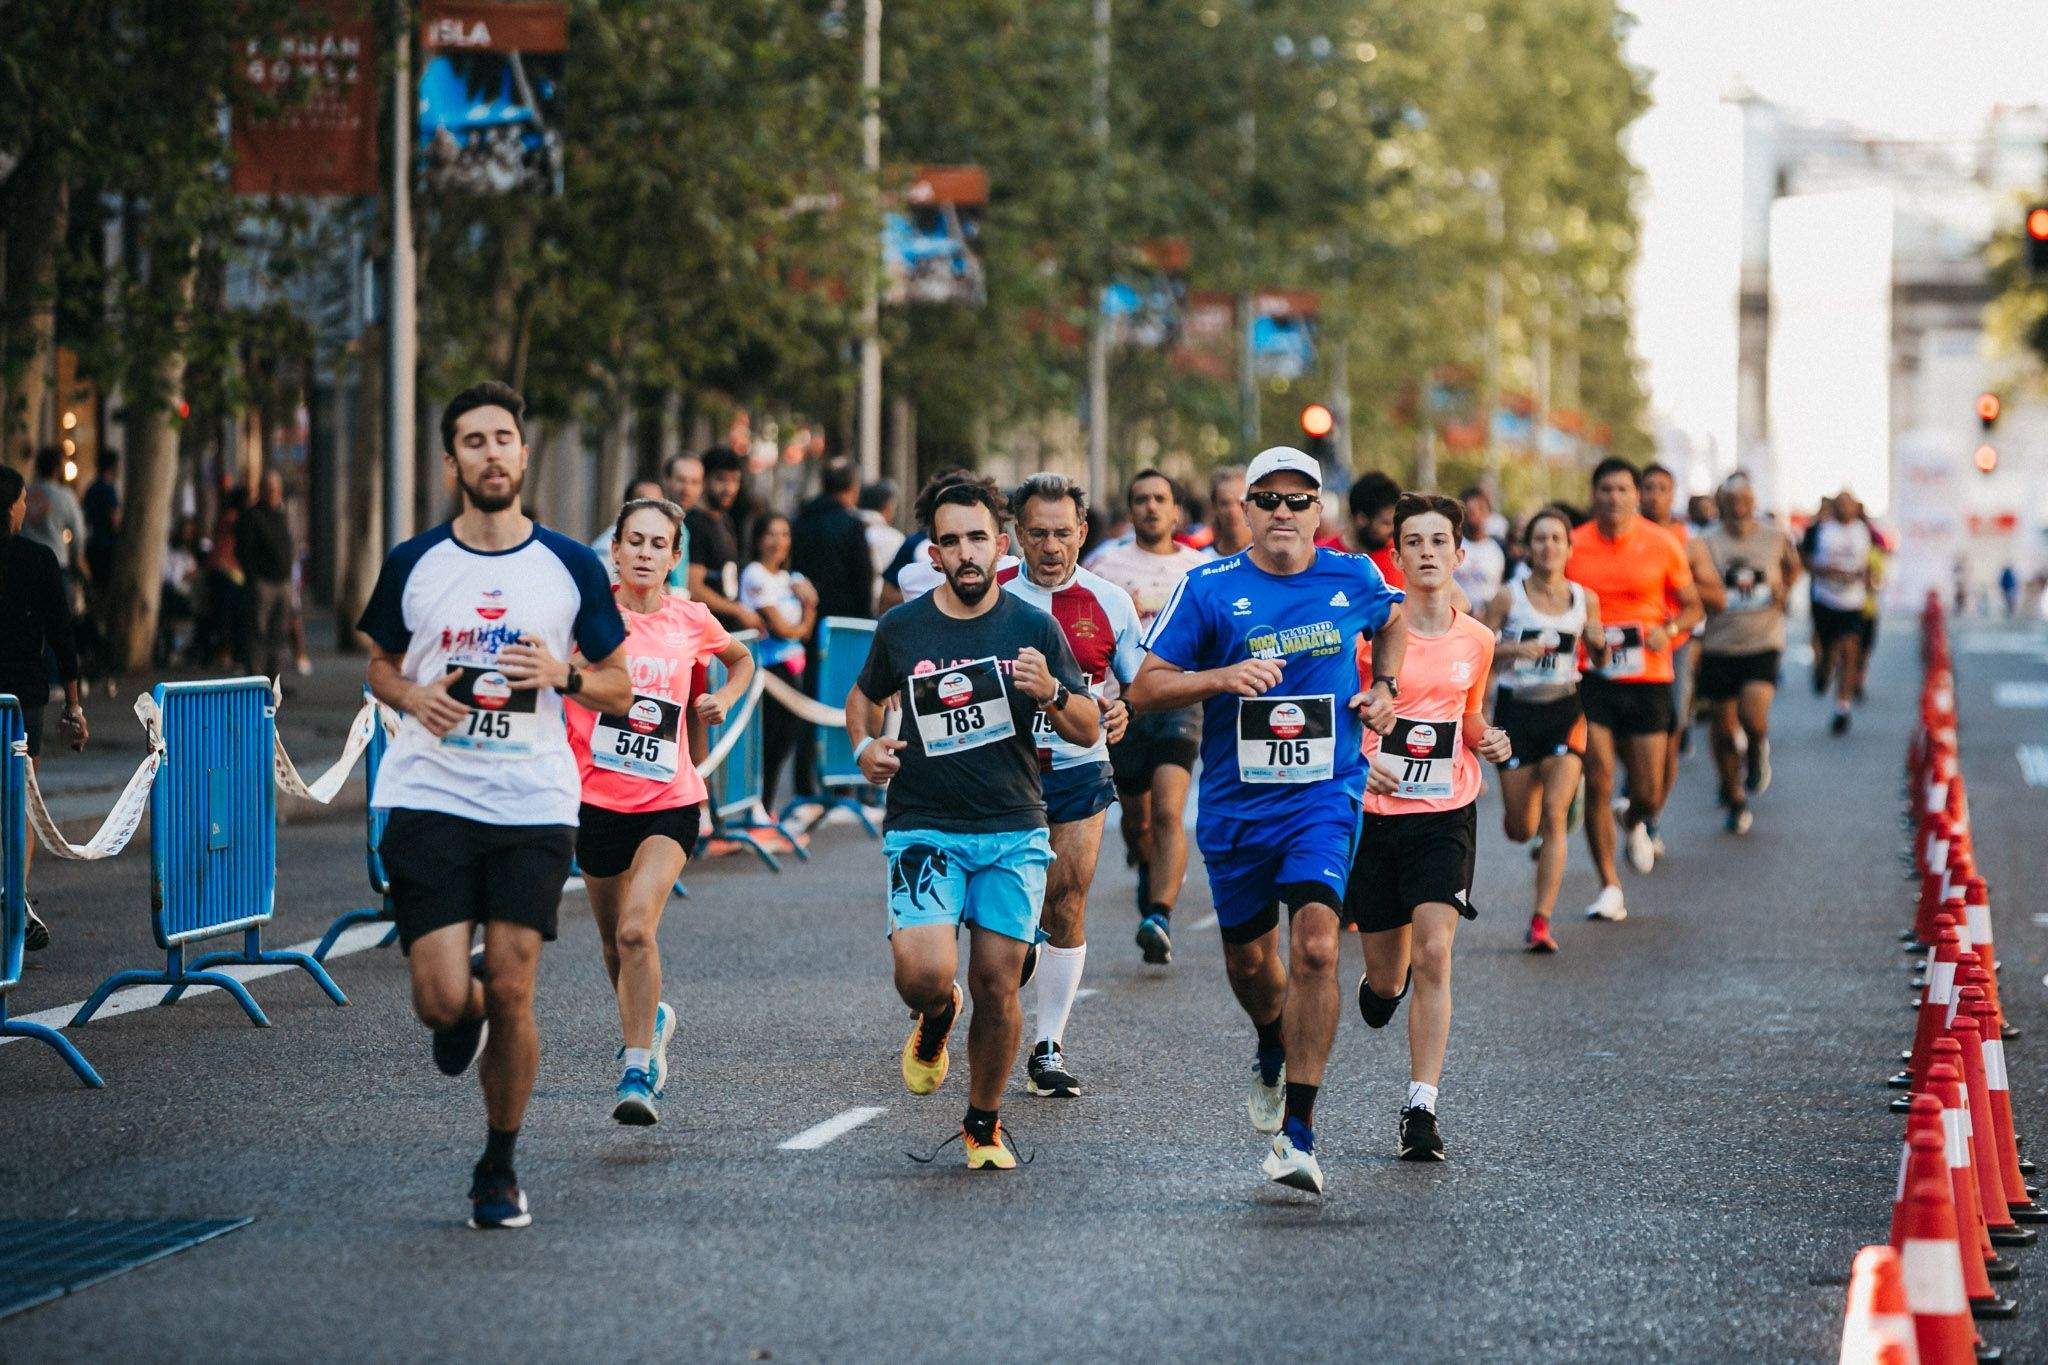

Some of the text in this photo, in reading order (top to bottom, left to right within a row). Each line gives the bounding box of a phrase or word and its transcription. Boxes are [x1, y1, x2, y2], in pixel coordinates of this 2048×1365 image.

[1201, 558, 1241, 577] Madrid
[1249, 633, 1279, 652] ROCK
[1281, 622, 1334, 640] MADRID
[1311, 645, 1341, 657] 2012
[467, 710, 510, 739] 745
[940, 705, 985, 736] 783
[616, 731, 660, 762] 545
[1266, 740, 1310, 766] 705
[1402, 758, 1432, 783] 777
